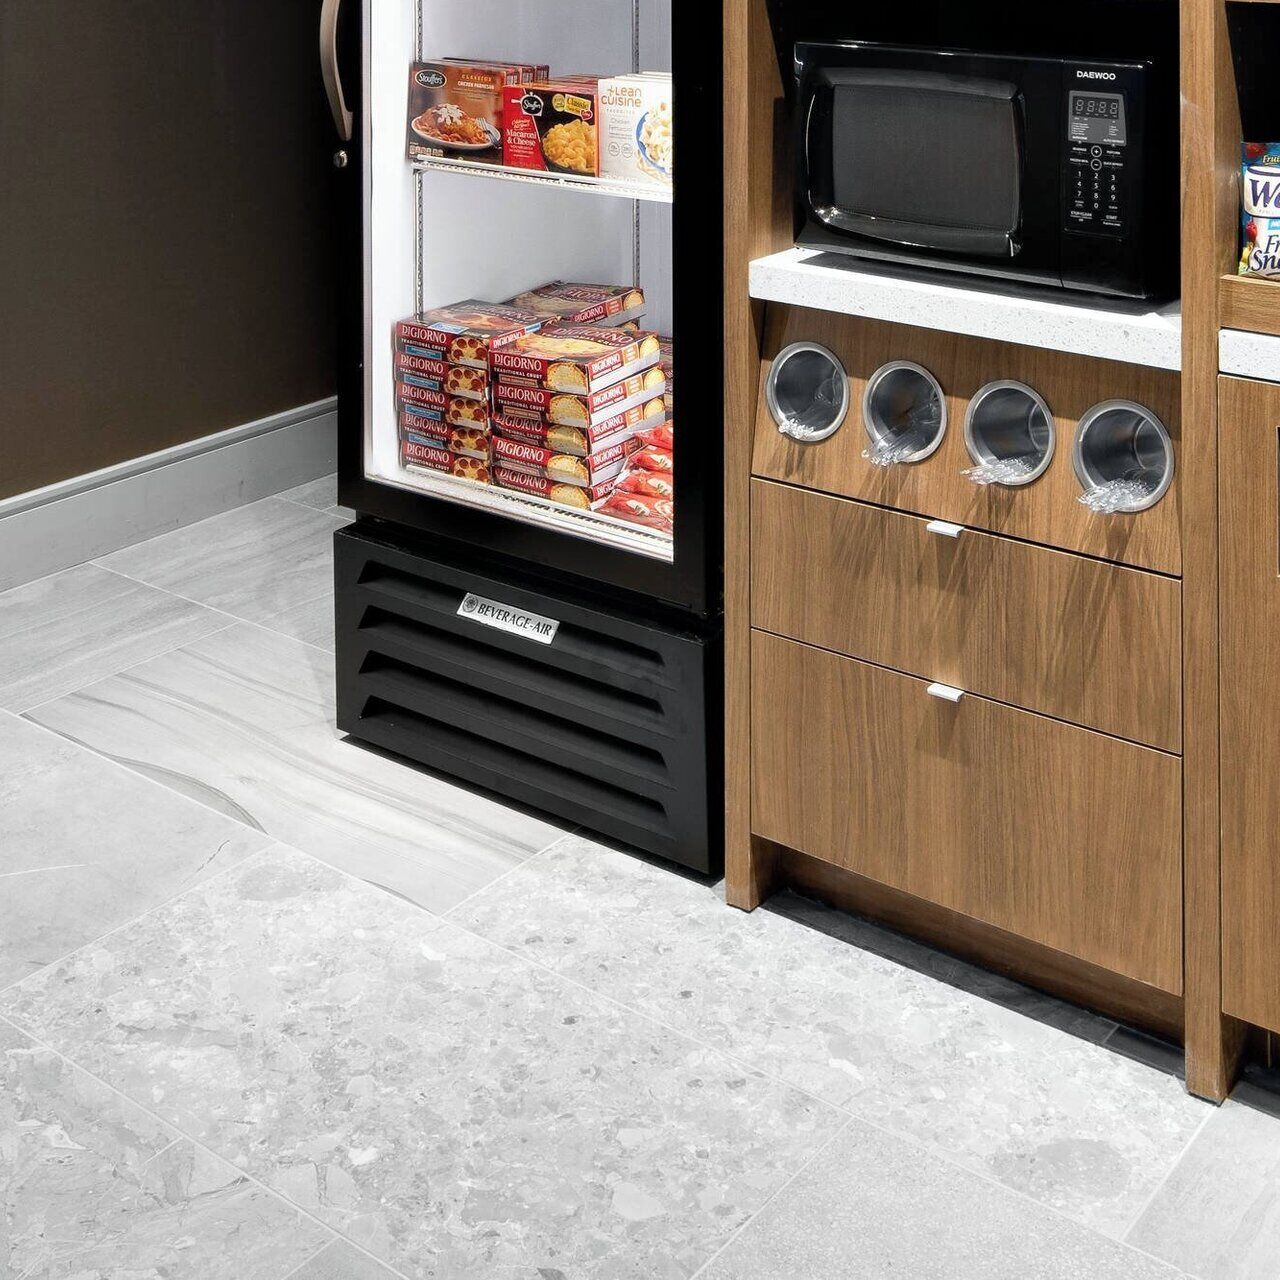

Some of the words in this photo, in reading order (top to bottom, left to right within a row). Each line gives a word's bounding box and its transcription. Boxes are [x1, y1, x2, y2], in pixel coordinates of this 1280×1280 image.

[418, 72, 444, 85] Stouffer's
[1076, 70, 1117, 81] DAEWOO
[615, 85, 642, 97] Lean
[506, 129, 537, 139] Macaroni
[513, 136, 536, 146] Cheese
[401, 324, 447, 344] DIGIORNO
[400, 354, 444, 374] DIGIORNO
[494, 352, 542, 371] DIGIORNO
[401, 384, 446, 404] DIGIORNO
[498, 385, 545, 404] DIGIORNO
[405, 414, 448, 434] DIGIORNO
[495, 413, 543, 433] DIGIORNO
[406, 443, 450, 463] DIGIORNO
[496, 439, 545, 462] DIGIORNO
[498, 469, 548, 490] DIGIORNO
[477, 603, 553, 636] BEVERAGE-AIR
